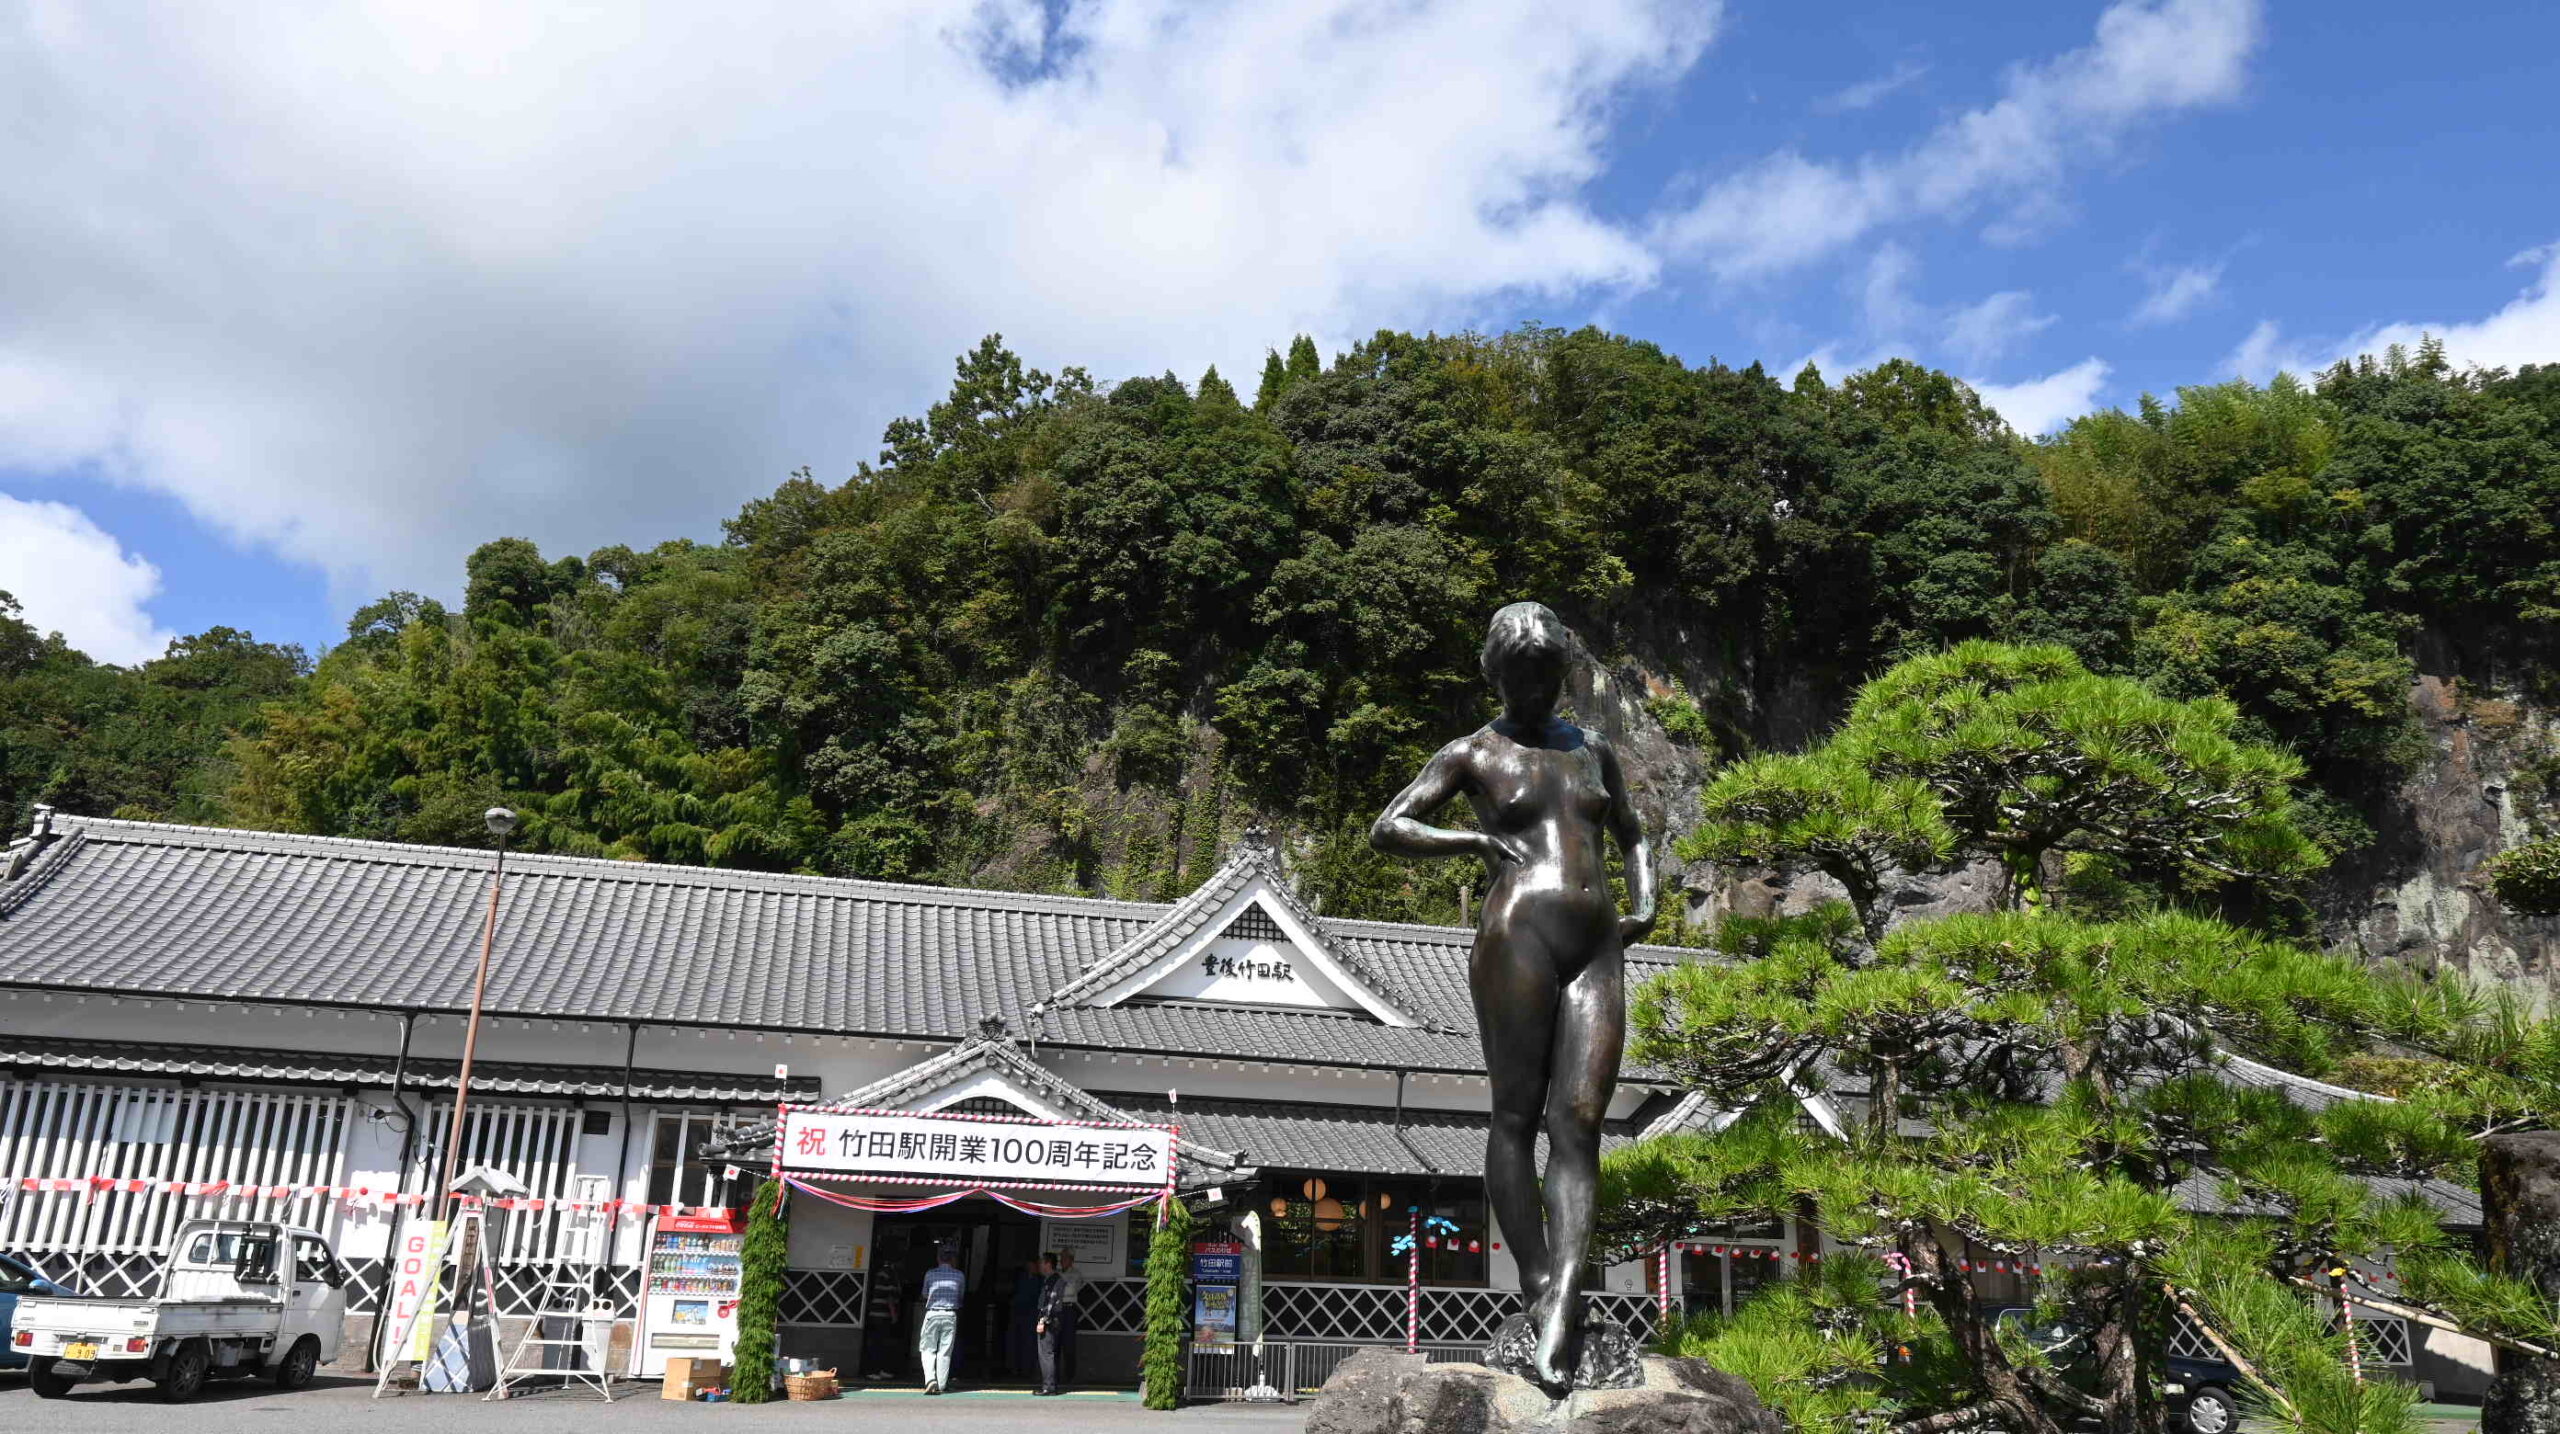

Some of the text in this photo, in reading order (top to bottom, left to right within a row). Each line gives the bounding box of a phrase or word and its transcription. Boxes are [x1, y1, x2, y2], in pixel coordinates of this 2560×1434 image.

[1201, 953, 1294, 981] 豊後竹田駅
[796, 1127, 1158, 1171] 祝 竹田駅開業100周年記念
[1200, 1258, 1232, 1268] 竹田駅前
